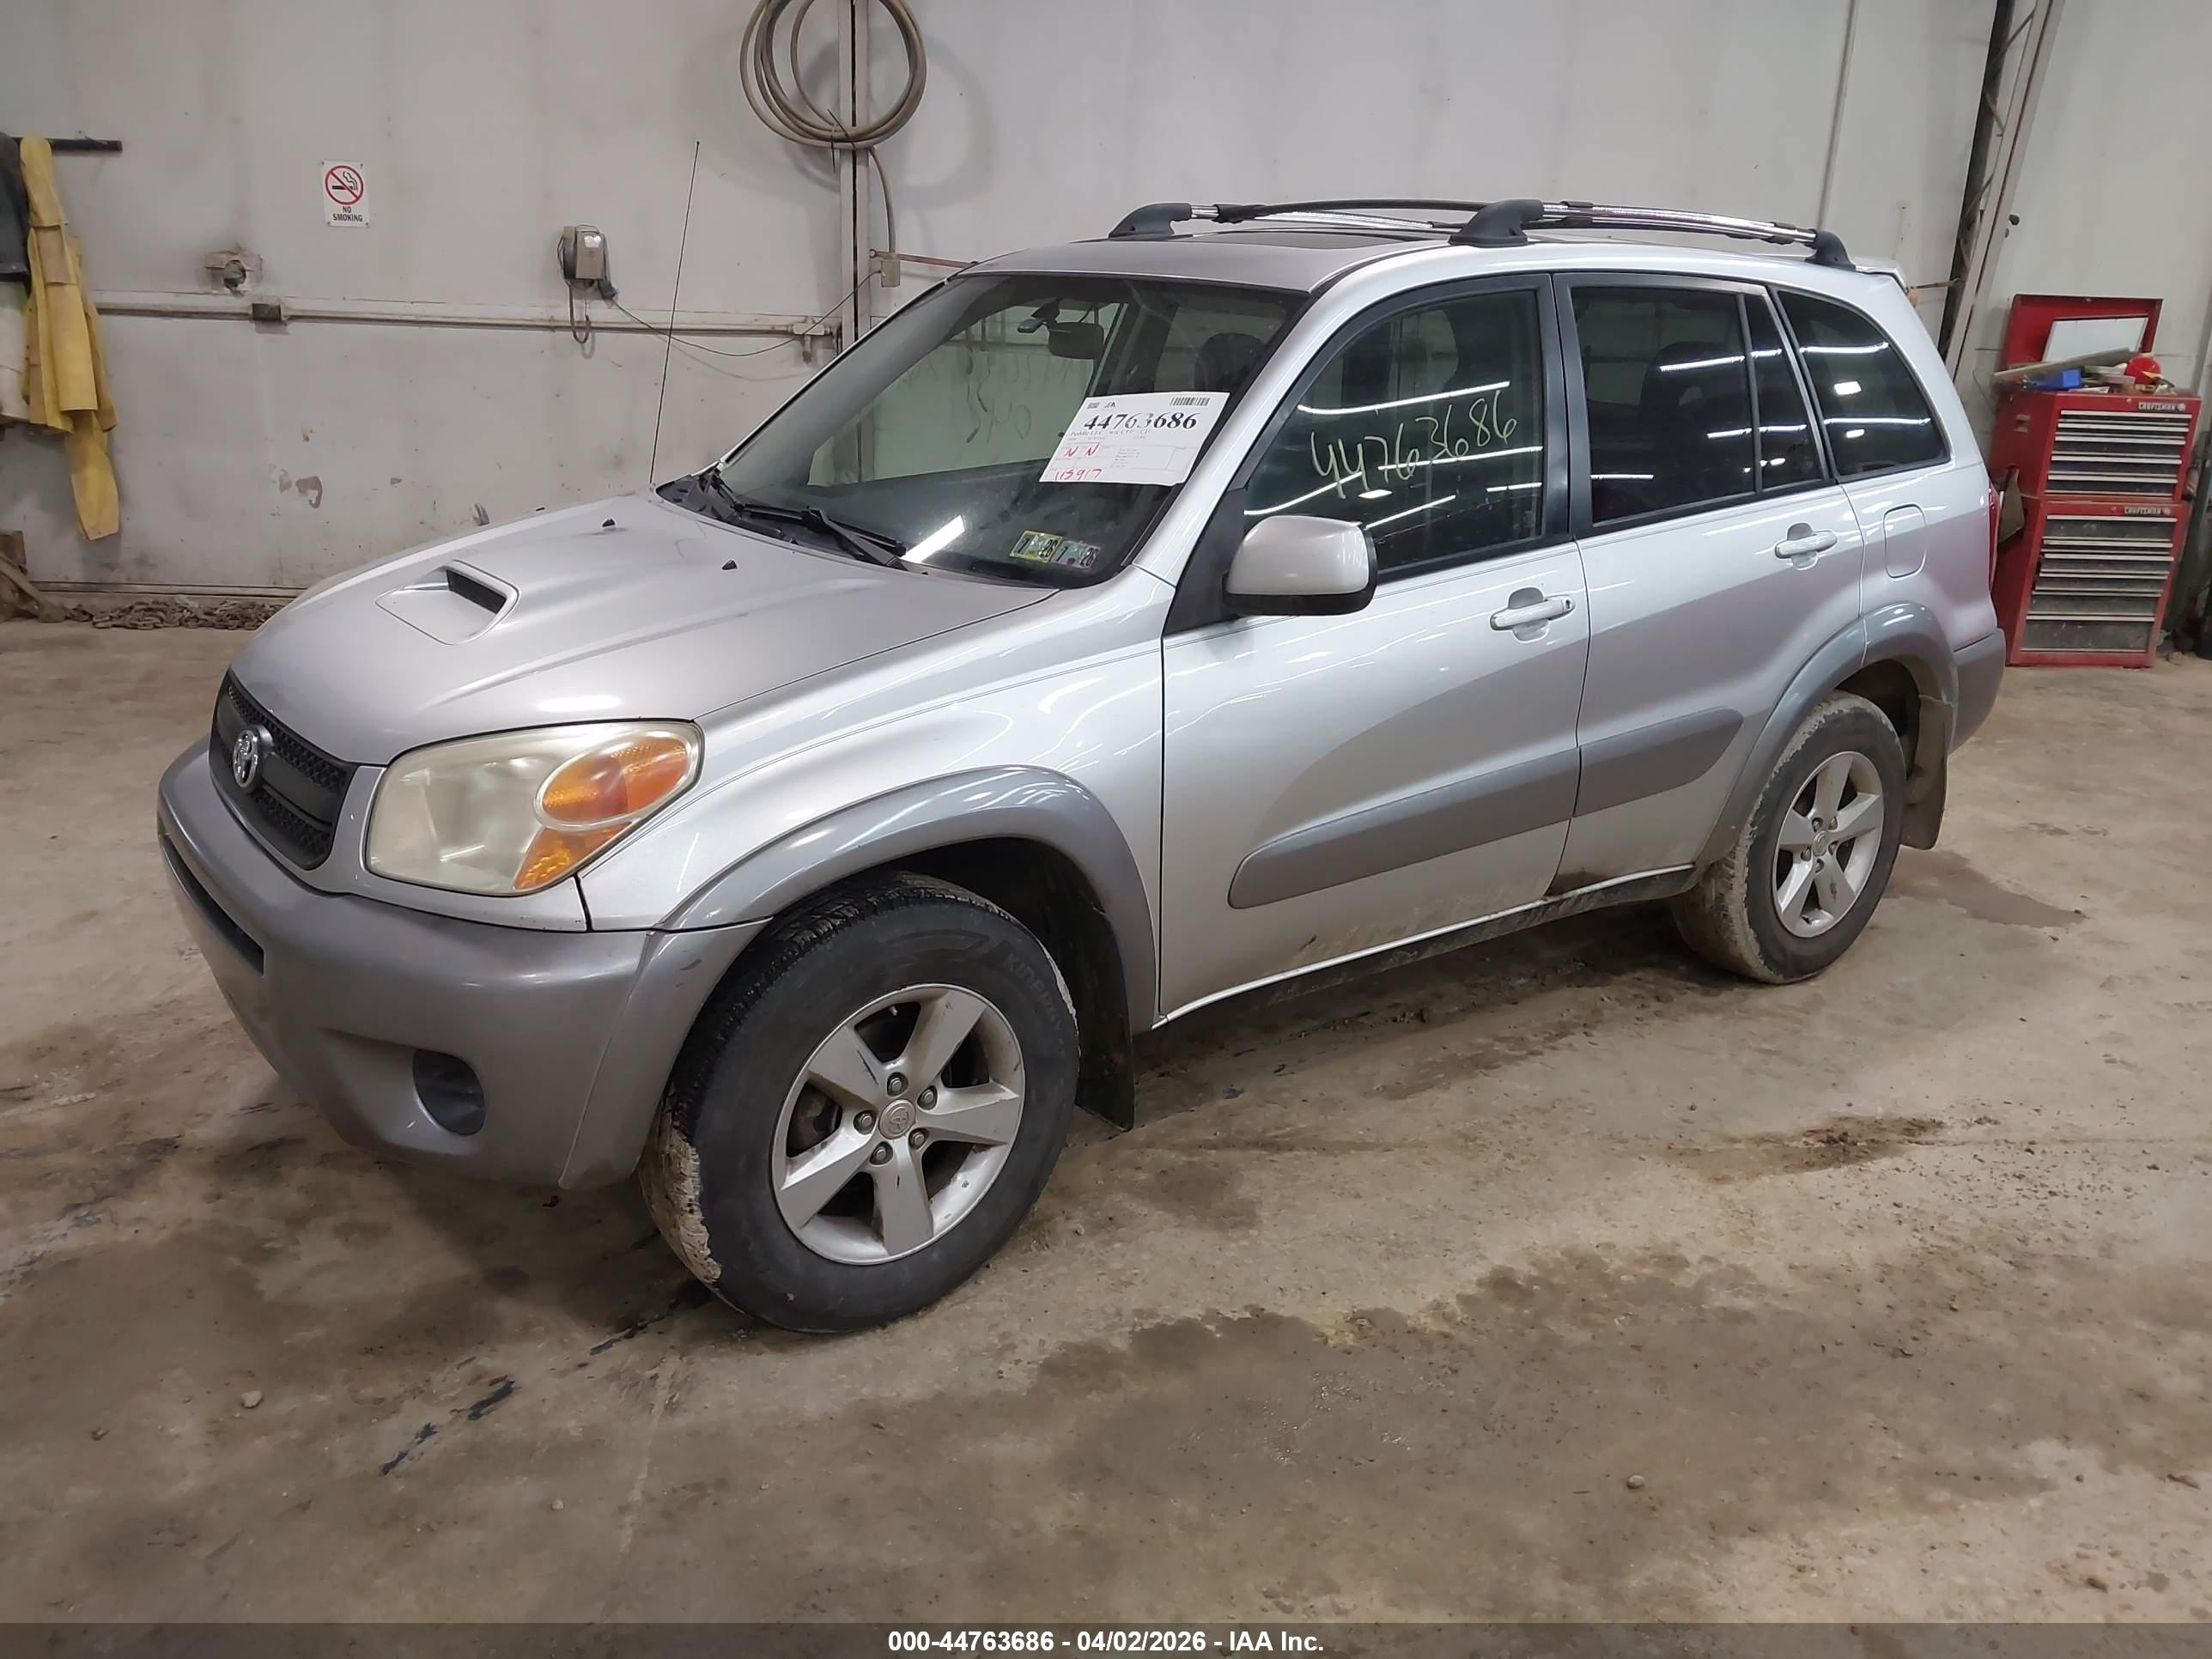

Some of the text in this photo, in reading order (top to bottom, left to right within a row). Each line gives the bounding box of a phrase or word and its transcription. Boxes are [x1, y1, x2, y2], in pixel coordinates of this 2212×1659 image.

[331, 213, 363, 222] SMOKING
[1084, 411, 1202, 430] 44763686
[1310, 389, 1518, 500] 44763686
